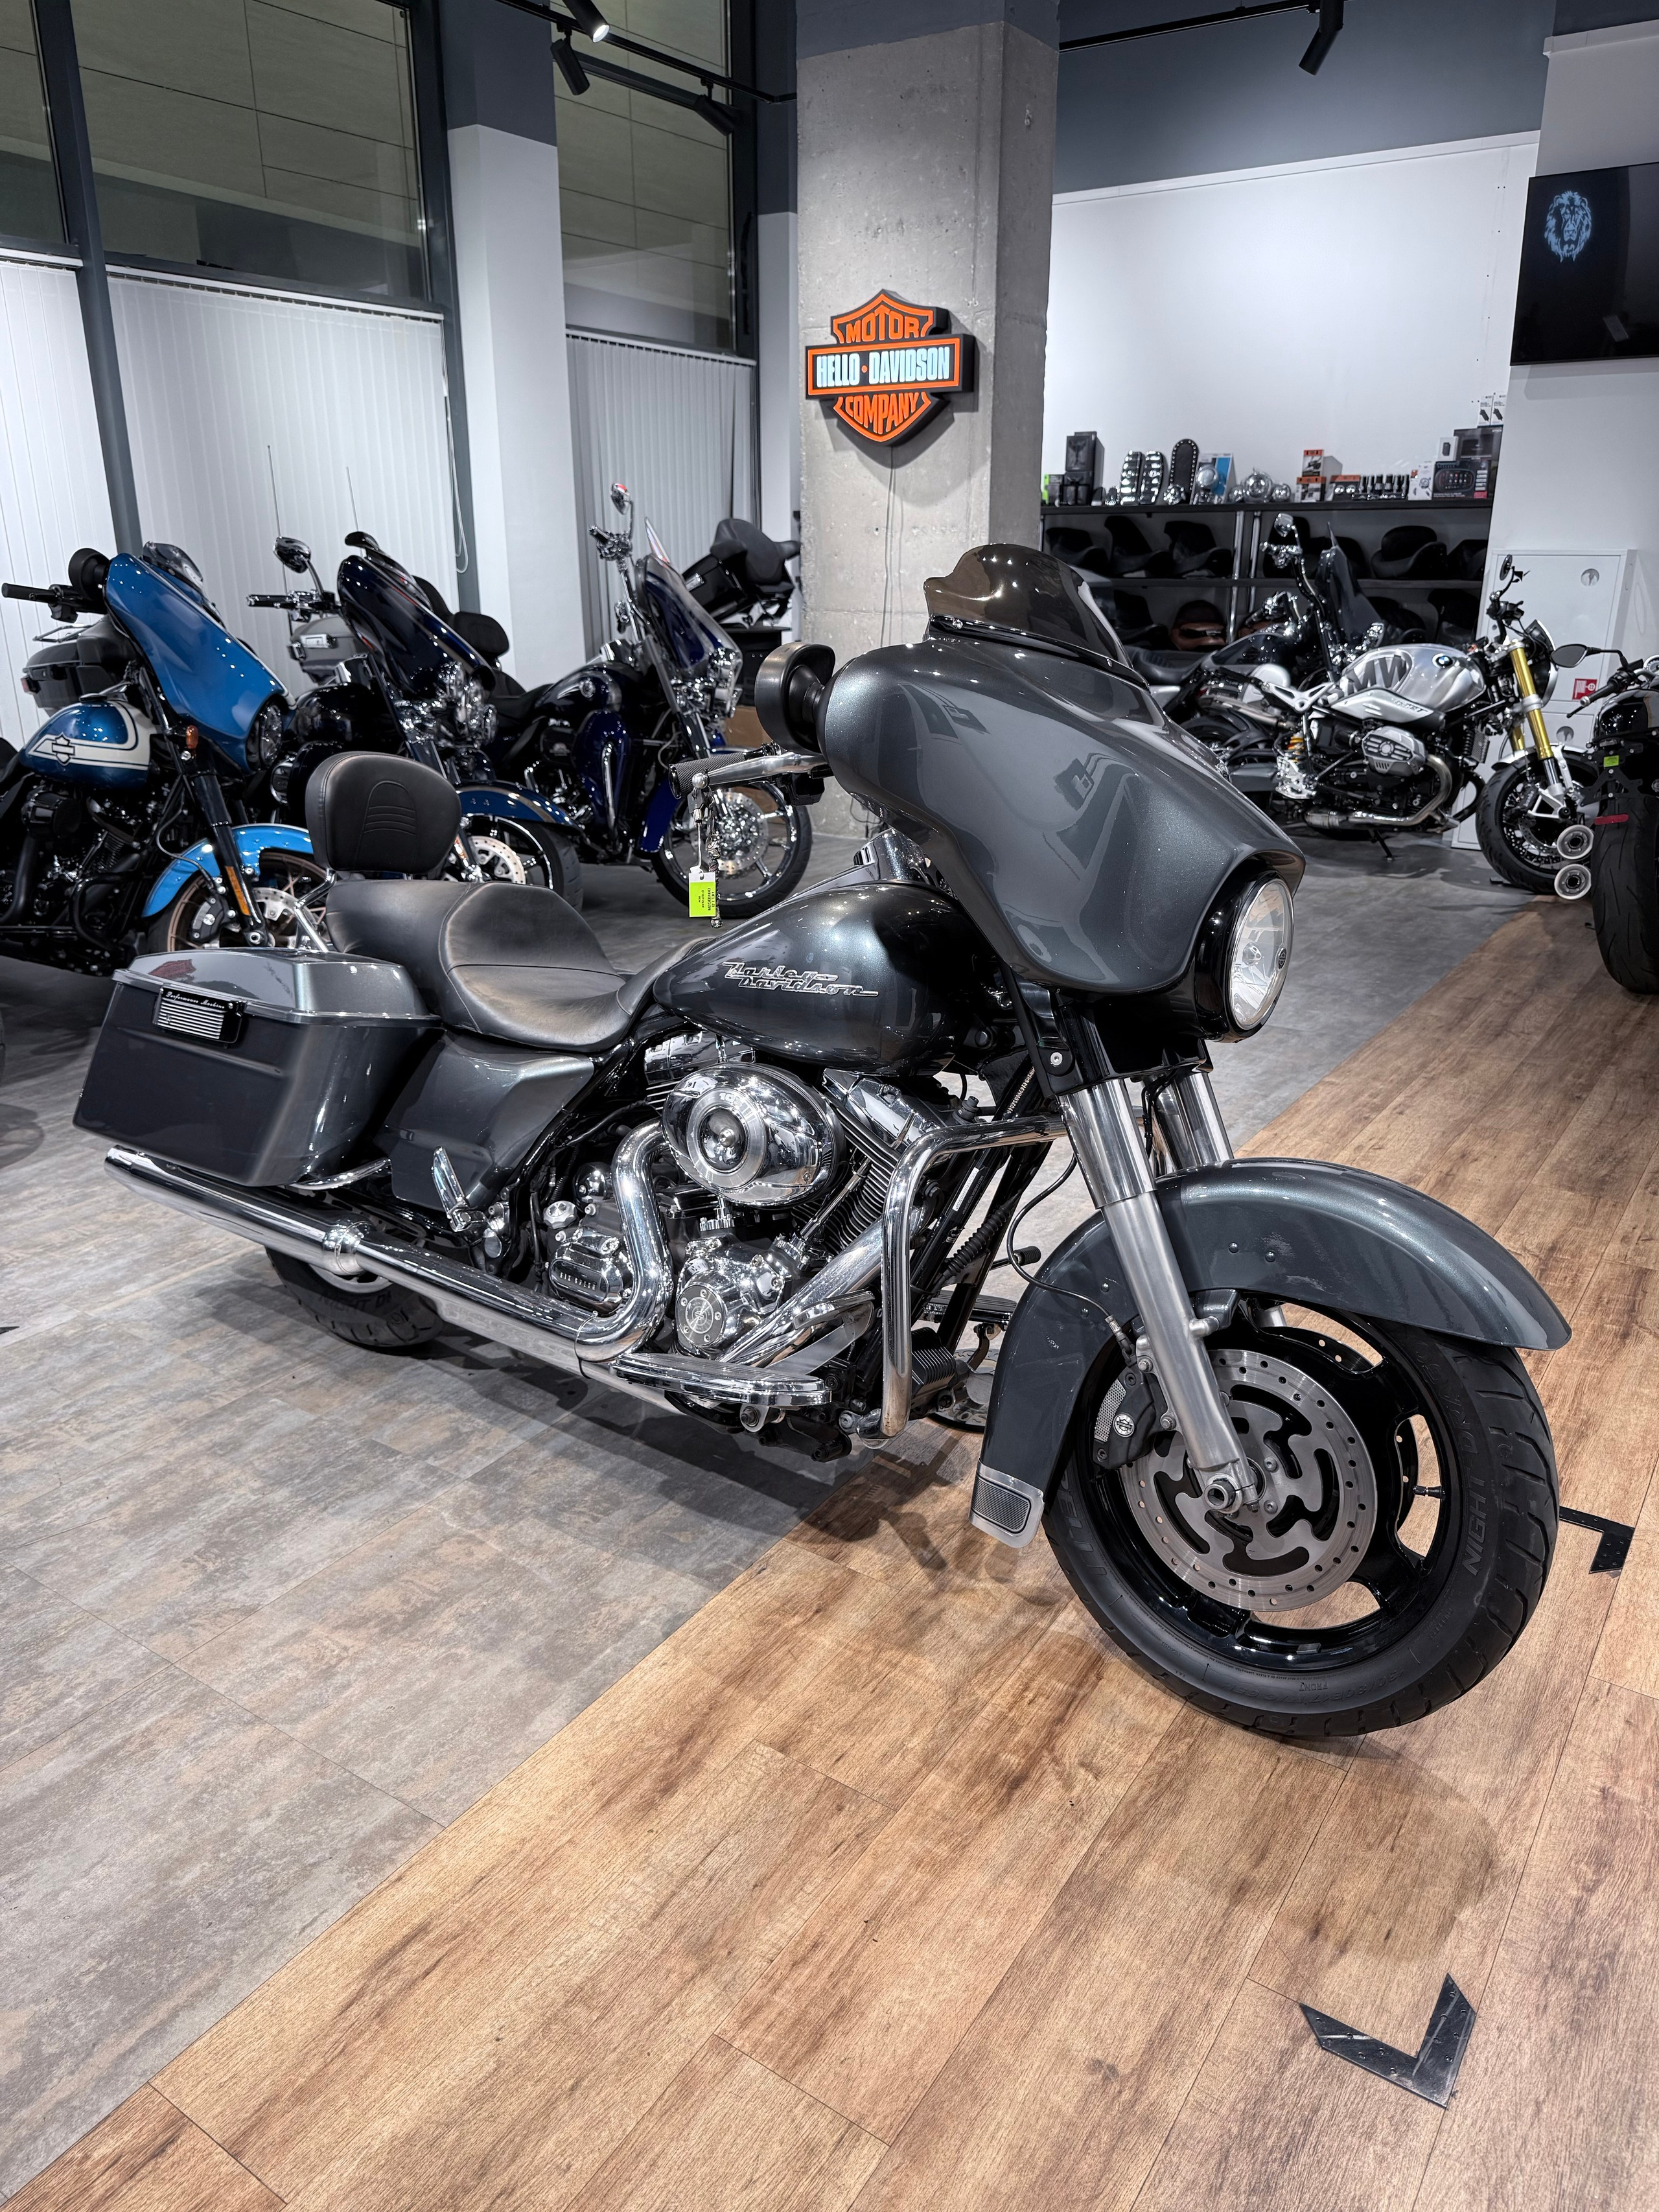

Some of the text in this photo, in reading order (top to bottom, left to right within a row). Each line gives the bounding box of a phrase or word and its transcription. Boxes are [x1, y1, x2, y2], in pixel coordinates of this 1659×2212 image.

[846, 305, 921, 343] MOTOR
[817, 346, 950, 388] HELLO DAVIDSON
[845, 392, 920, 434] COMPANY
[560, 1272, 571, 1281] SIX
[1462, 1475, 1487, 1576] NIGHT
[1298, 1682, 1328, 1692] FRONT
